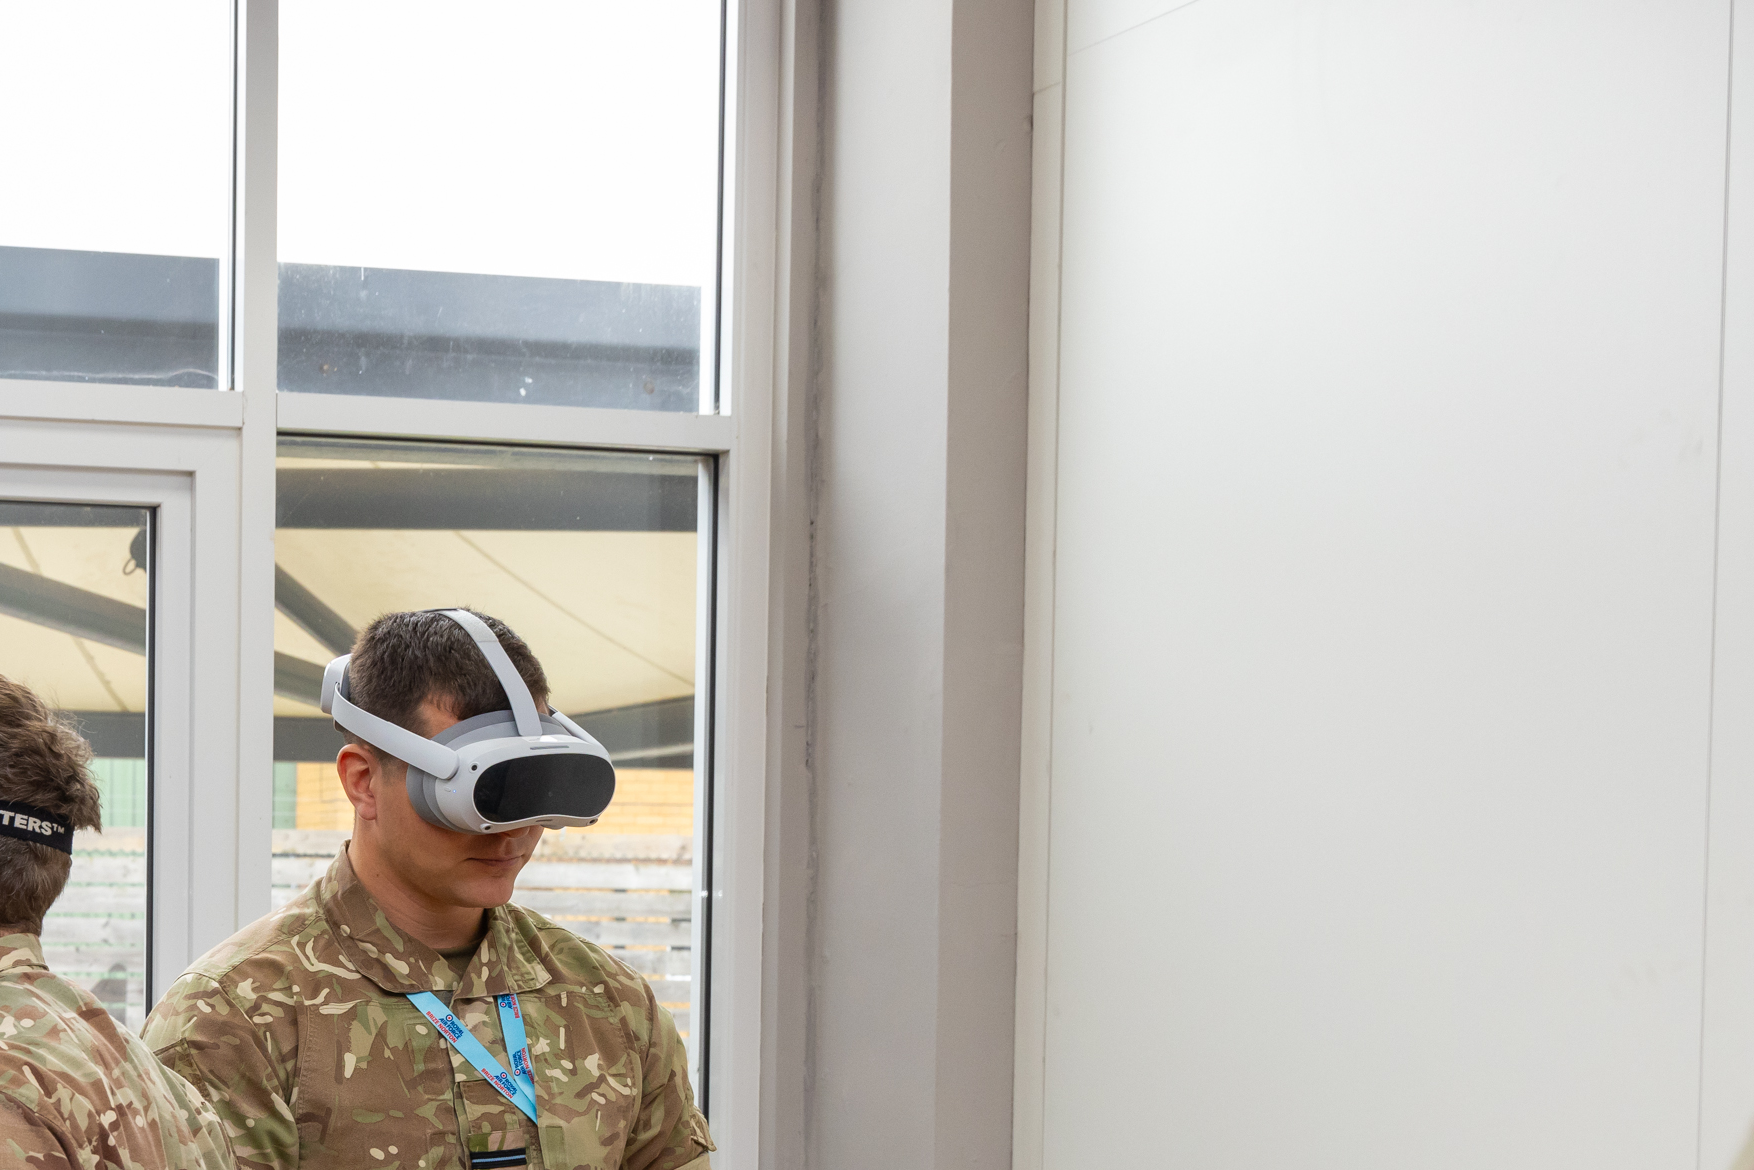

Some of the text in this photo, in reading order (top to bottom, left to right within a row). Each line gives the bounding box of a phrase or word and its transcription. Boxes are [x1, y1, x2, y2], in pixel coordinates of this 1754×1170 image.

[426, 1011, 457, 1043] BRIZE NORTON
[520, 1047, 531, 1070] NORTON
[493, 1079, 513, 1099] NORTON
